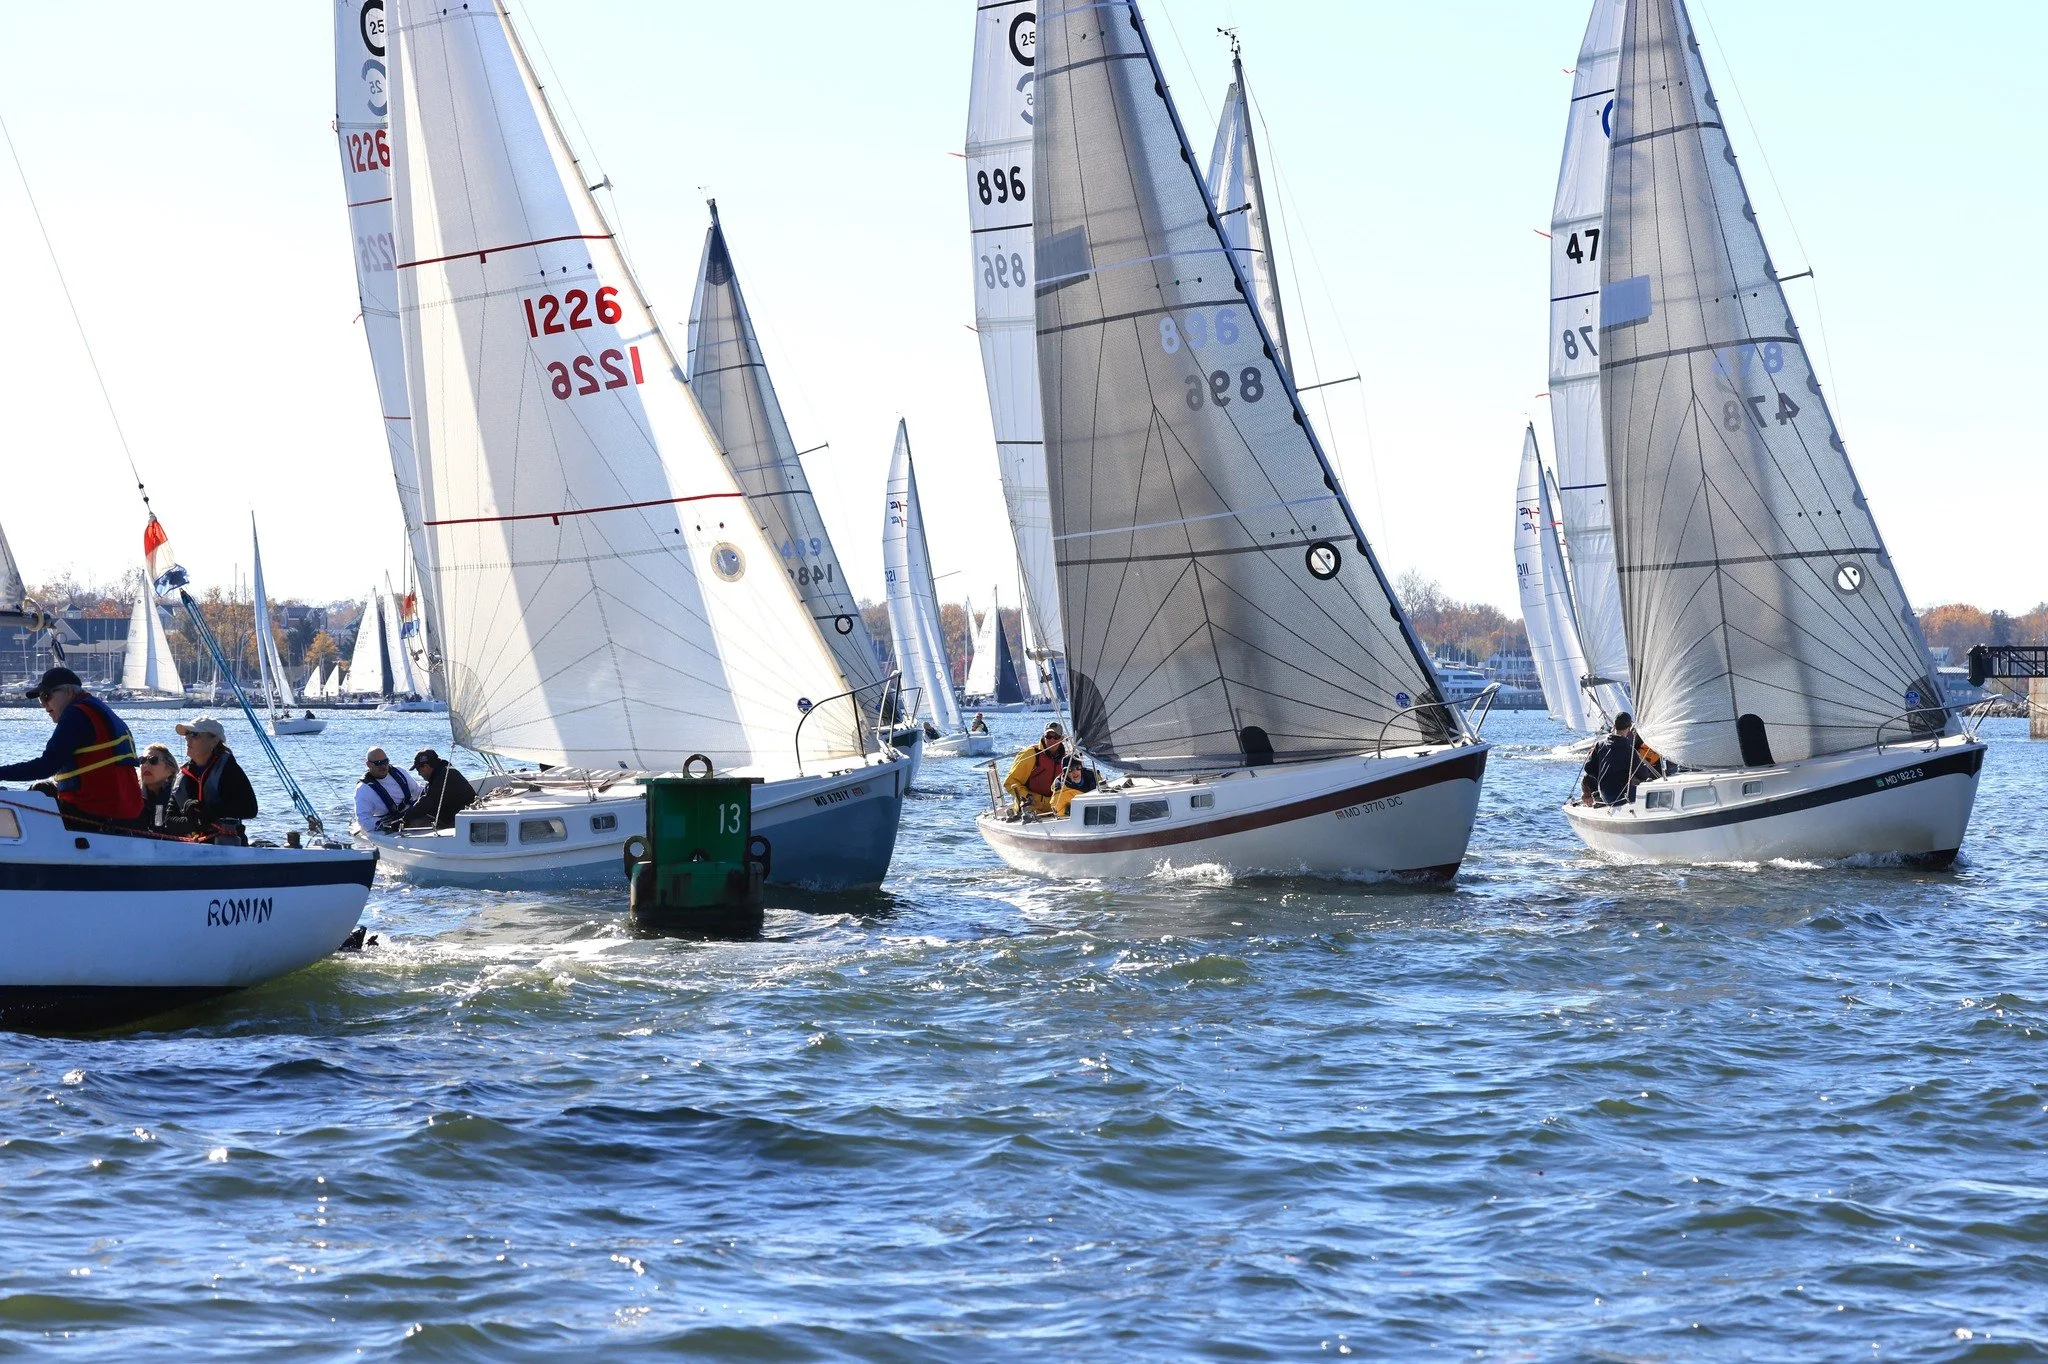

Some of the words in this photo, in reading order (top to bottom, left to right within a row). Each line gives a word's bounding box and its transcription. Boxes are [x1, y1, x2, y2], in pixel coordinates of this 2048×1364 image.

[369, 19, 385, 35] 25
[1021, 31, 1036, 46] 25
[346, 129, 391, 173] 1226
[977, 165, 1026, 205] 896
[523, 286, 622, 338] 1226
[1159, 308, 1240, 355] 896
[1884, 775, 1898, 785] MD
[1916, 768, 1924, 777] S
[719, 803, 741, 834] 13
[1344, 806, 1361, 818] MD
[1362, 801, 1386, 814] 3770
[1386, 796, 1403, 808] DC
[207, 897, 273, 927] RONIN
